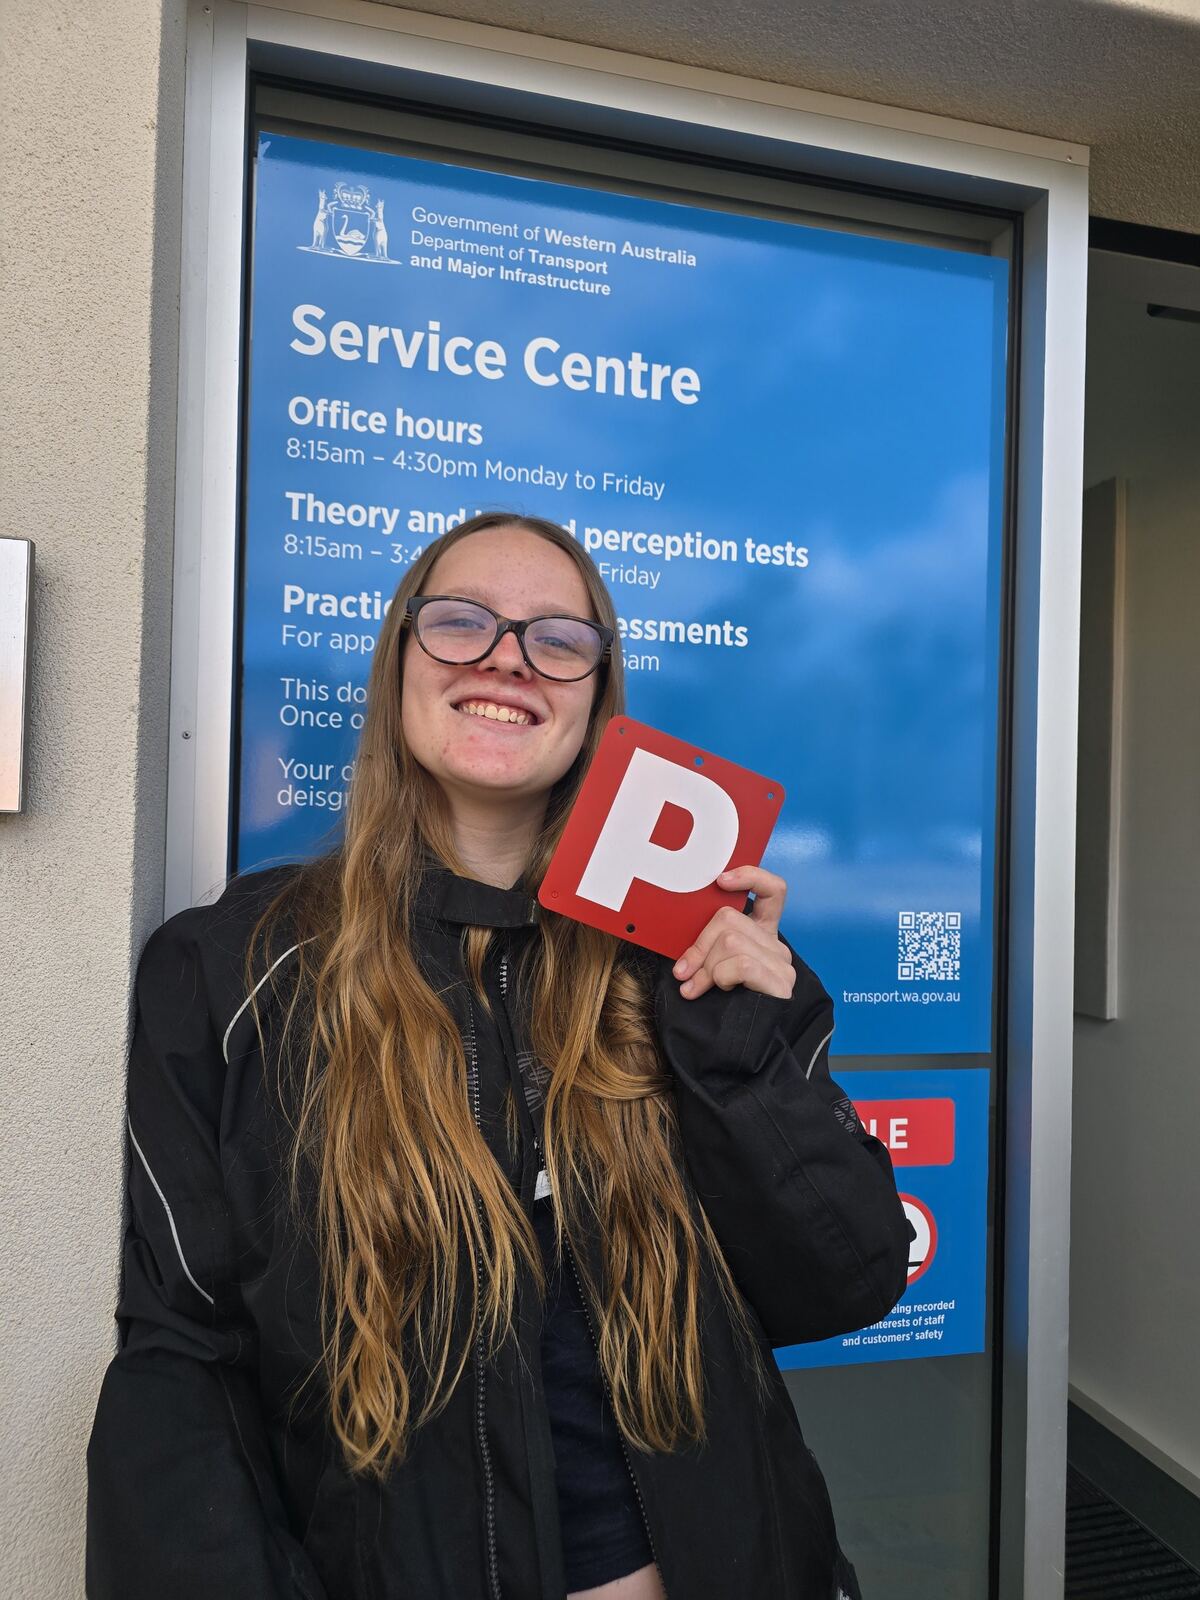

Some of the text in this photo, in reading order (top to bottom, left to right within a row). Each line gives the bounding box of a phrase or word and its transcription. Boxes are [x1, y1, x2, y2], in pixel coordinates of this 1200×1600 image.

[411, 206, 696, 266] Government of Western Australia
[411, 231, 609, 275] Department of Transport
[411, 256, 611, 296] and Major Infrastructure
[291, 305, 700, 404] Service Centre
[289, 397, 482, 445] Office hours
[287, 438, 364, 465] 8:15am
[393, 450, 476, 477] 4:30pm
[486, 460, 567, 490] Monday
[576, 470, 595, 489] to
[604, 473, 664, 500] Friday
[285, 491, 400, 534] Theory
[408, 509, 465, 534] and
[584, 527, 738, 561] perception
[745, 538, 808, 567] tests
[284, 534, 362, 560] 8:15am
[391, 544, 422, 563] 3:4
[599, 563, 660, 589] Friday
[284, 585, 748, 646] Practi essments
[283, 625, 322, 647] For
[330, 634, 375, 654] app
[281, 678, 367, 703] This do
[280, 705, 342, 728] Once
[278, 758, 334, 780] Your
[277, 784, 348, 811] deisg
[575, 746, 740, 912] P
[842, 990, 961, 1005] transport.wa.gov.au
[891, 1300, 954, 1314] eing recorded
[913, 1317, 922, 1326] of
[924, 1314, 944, 1325] staff
[843, 1336, 860, 1346] and
[916, 1330, 943, 1340] safety
